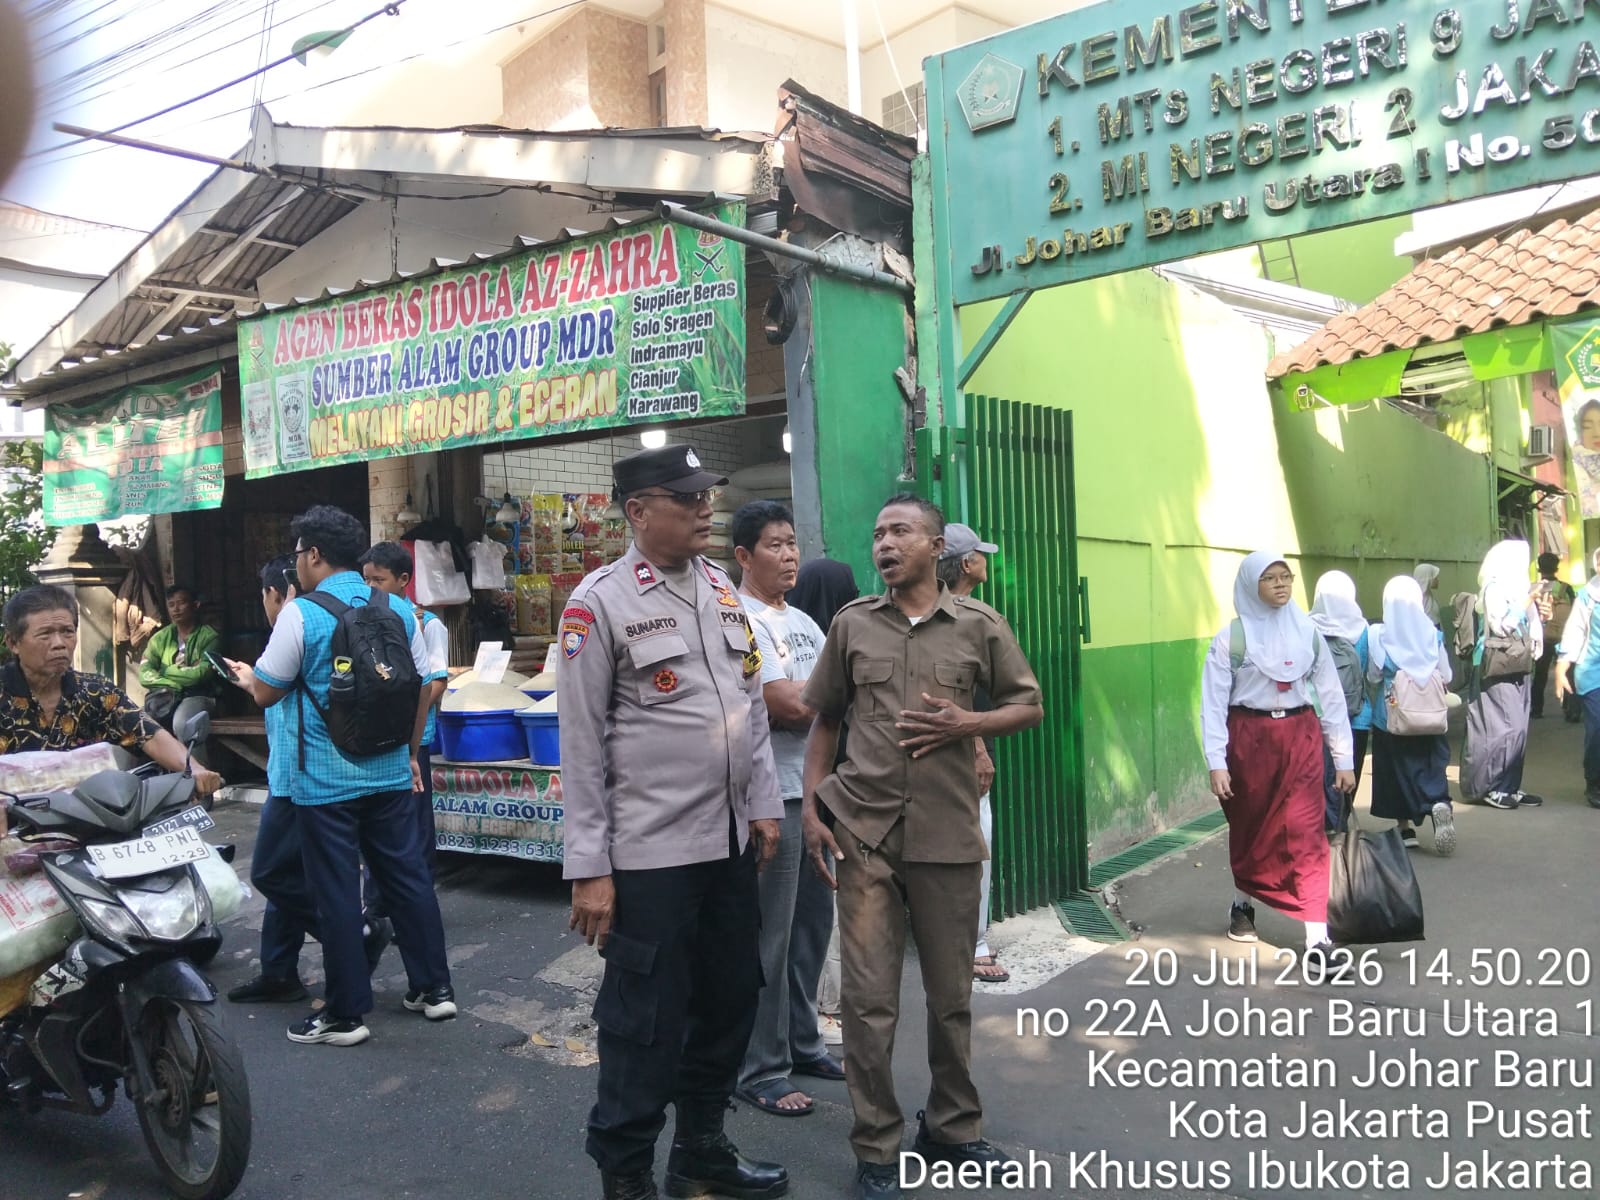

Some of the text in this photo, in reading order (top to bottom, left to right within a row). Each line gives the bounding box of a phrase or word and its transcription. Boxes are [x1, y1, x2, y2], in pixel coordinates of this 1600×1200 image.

[1037, 0, 1372, 96] KEMEN
[1048, 116, 1080, 155] 1.
[1209, 22, 1408, 114] NEGERI
[1431, 9, 1462, 54] 9
[1048, 172, 1083, 213] 2.
[1101, 151, 1149, 200] MI
[1169, 99, 1362, 185] NEGERI
[1387, 87, 1417, 136] 2
[1015, 221, 1132, 265] Johar
[1145, 195, 1249, 238] Baru
[1264, 163, 1405, 210] Utara
[1445, 132, 1531, 172] No.
[274, 226, 678, 364] AGEN BERAS IDOLA AZ-ZAHRA
[633, 282, 736, 313] Supplier Beras
[632, 311, 713, 338] Solo Sragen
[312, 308, 615, 406] SUMBER ALAM GROUP MDR
[631, 340, 703, 364] Indramayu
[630, 369, 678, 389] Cianjur
[309, 367, 617, 458] MELAYANI GROSIR & ECERAN
[629, 393, 698, 416] Karawang
[454, 769, 538, 800] IDOLA
[434, 797, 564, 821] ALAM GROUP
[438, 833, 475, 849] 0823
[481, 838, 520, 853] 1233
[481, 819, 538, 839] ECERAN
[94, 829, 199, 861] B 6748 PNL
